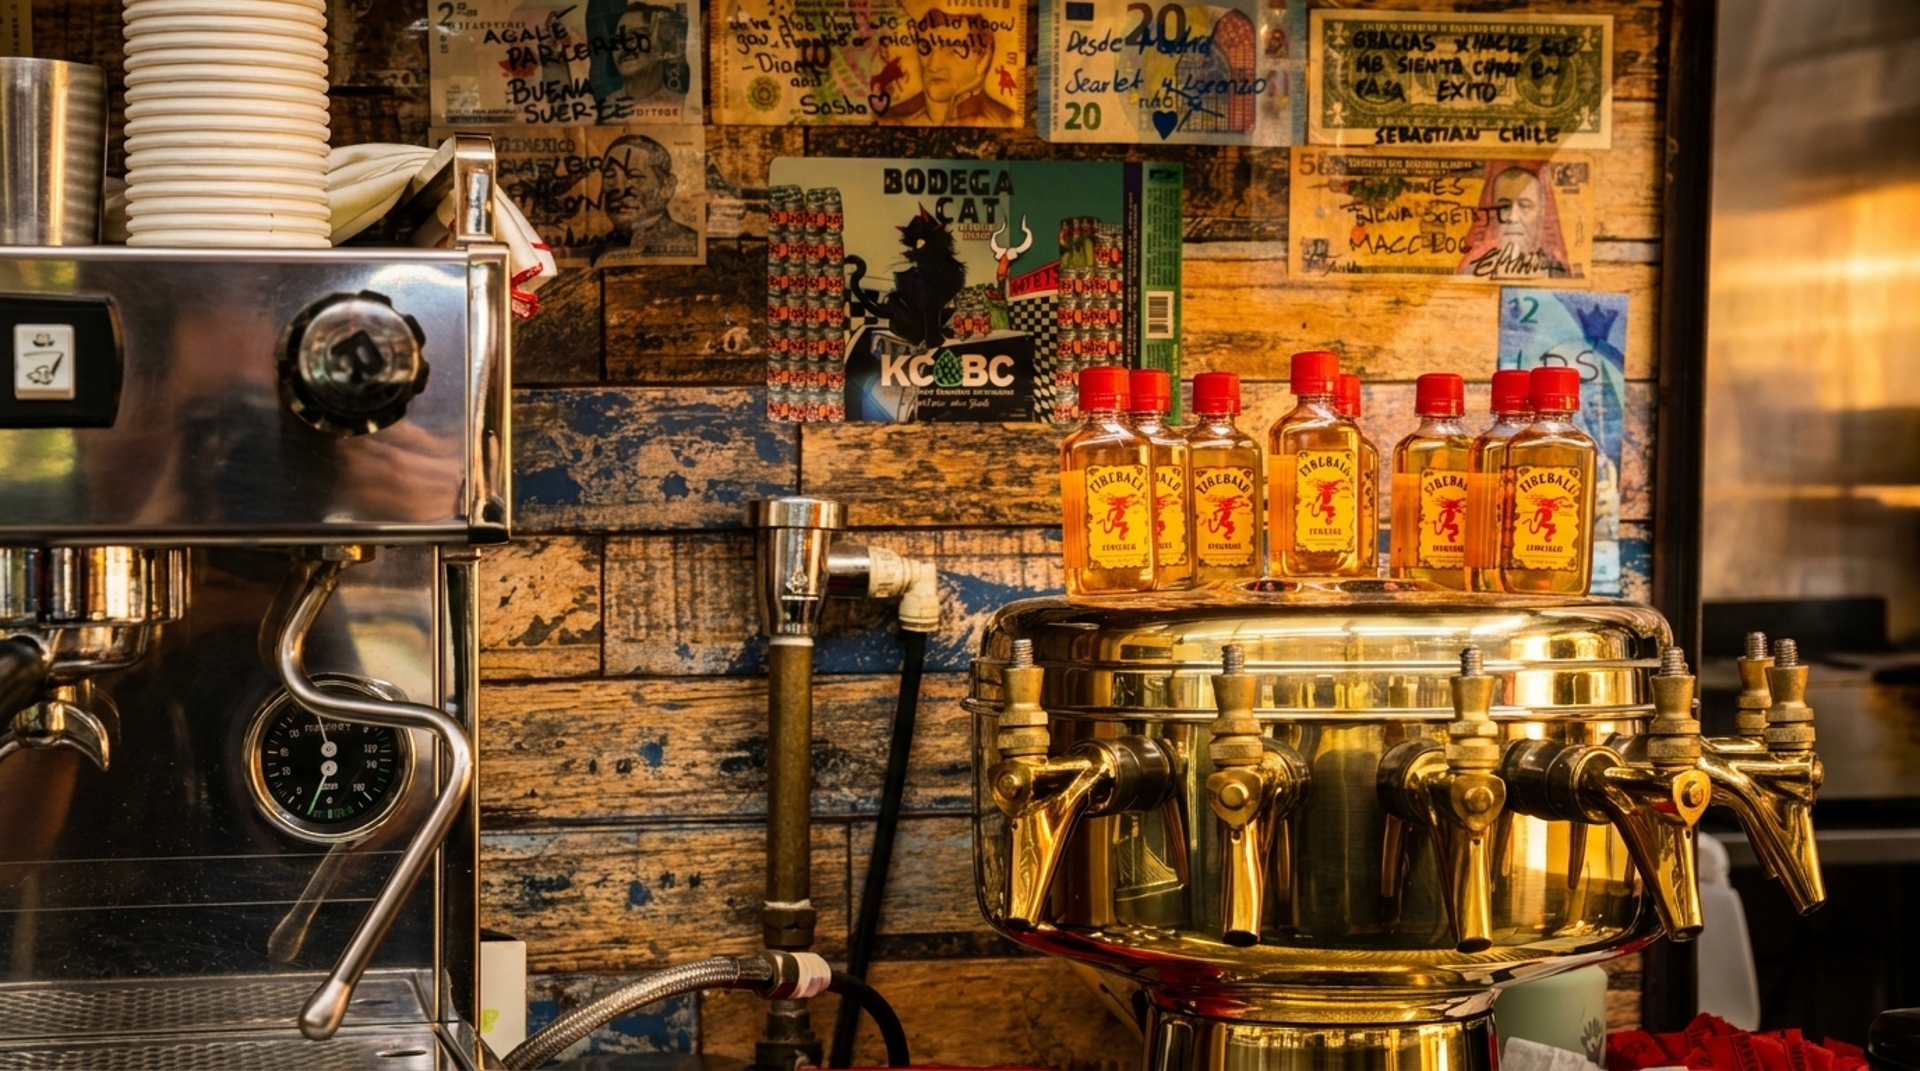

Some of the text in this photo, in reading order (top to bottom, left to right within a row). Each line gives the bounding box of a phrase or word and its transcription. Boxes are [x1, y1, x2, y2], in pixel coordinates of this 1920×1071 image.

[1065, 102, 1101, 130] 20
[884, 168, 1015, 196] BODEGA
[935, 197, 1000, 224] CAT
